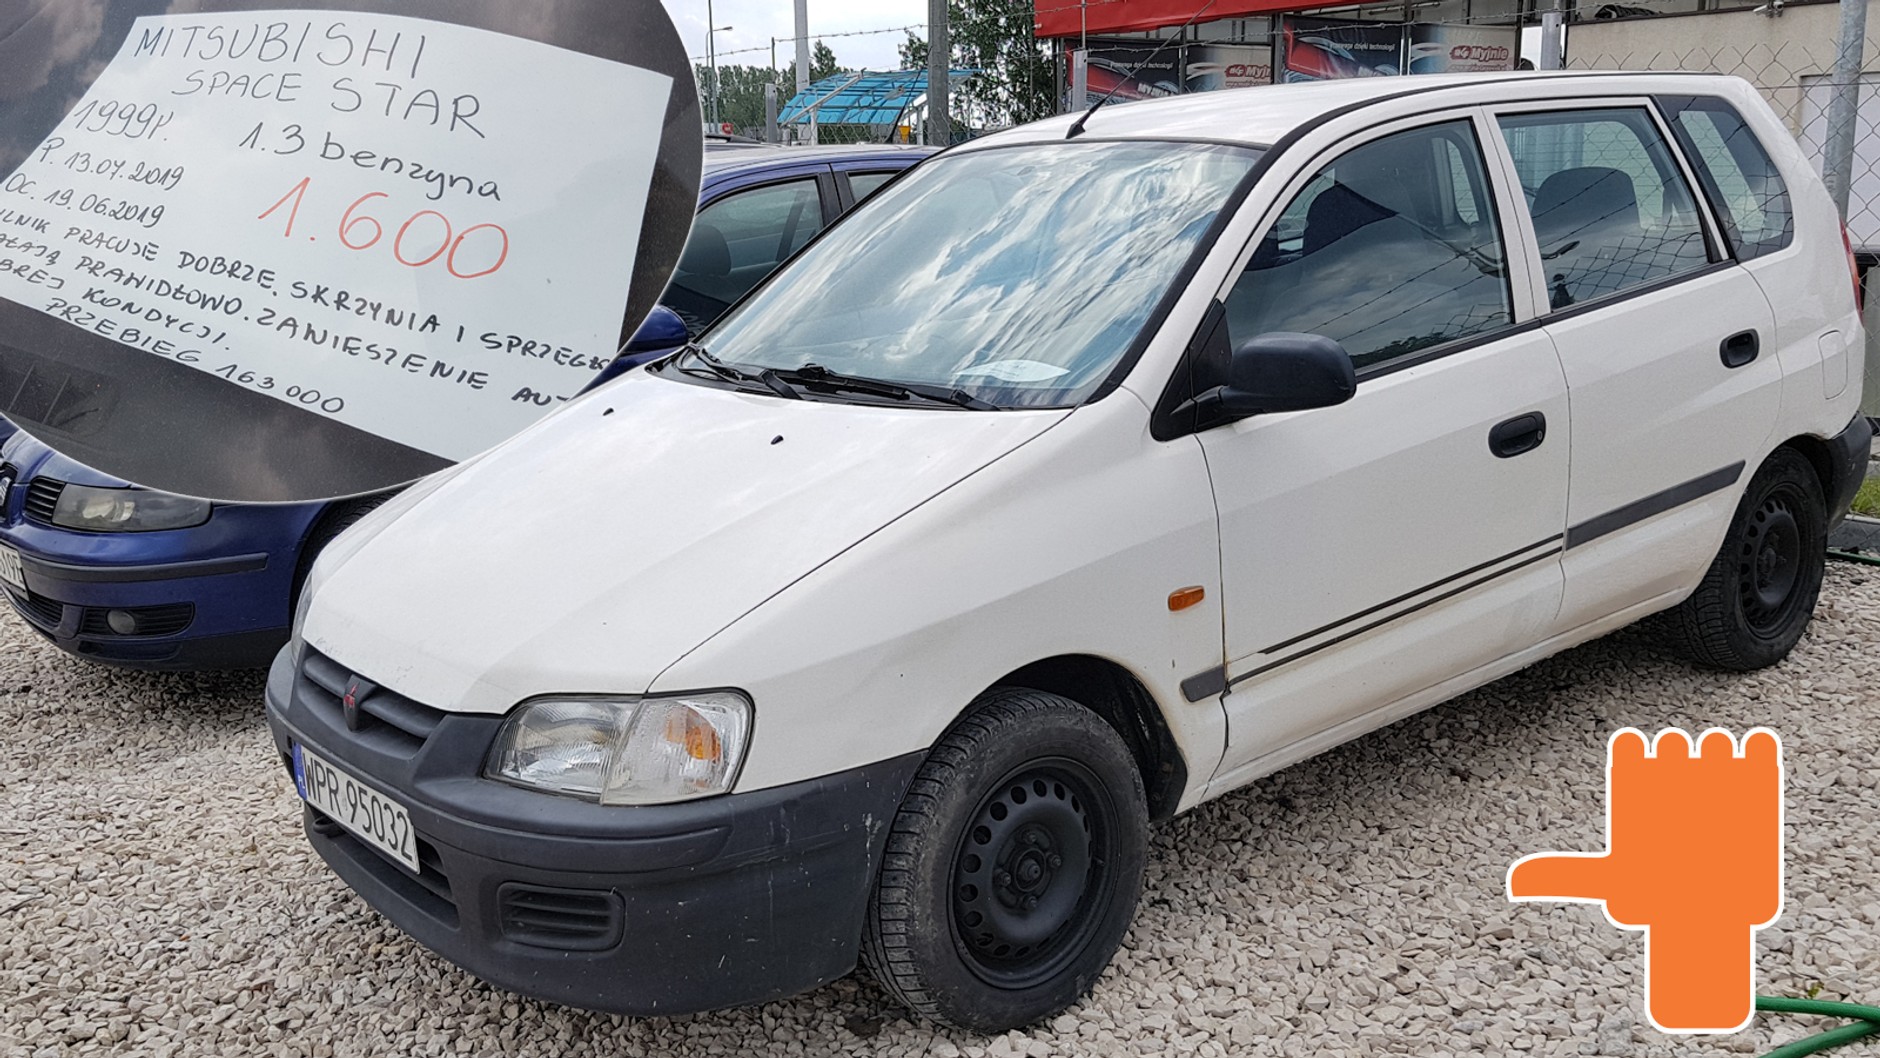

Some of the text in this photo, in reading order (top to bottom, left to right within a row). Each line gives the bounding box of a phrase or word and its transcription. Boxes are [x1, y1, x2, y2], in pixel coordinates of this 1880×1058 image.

[134, 22, 425, 78] MITSUBISHI
[1470, 46, 1508, 61] Myjnie
[171, 70, 485, 138] SPACE STAR
[239, 122, 305, 154] 1.3
[320, 132, 501, 200] benzyna
[257, 176, 509, 278] 1.600
[64, 227, 159, 261] PRACUJE
[177, 251, 278, 297] DOBRZE.
[290, 281, 440, 332] SKRZYNIA
[46, 297, 201, 362] PRZEBIEG
[303, 753, 413, 861] WPR 95032
